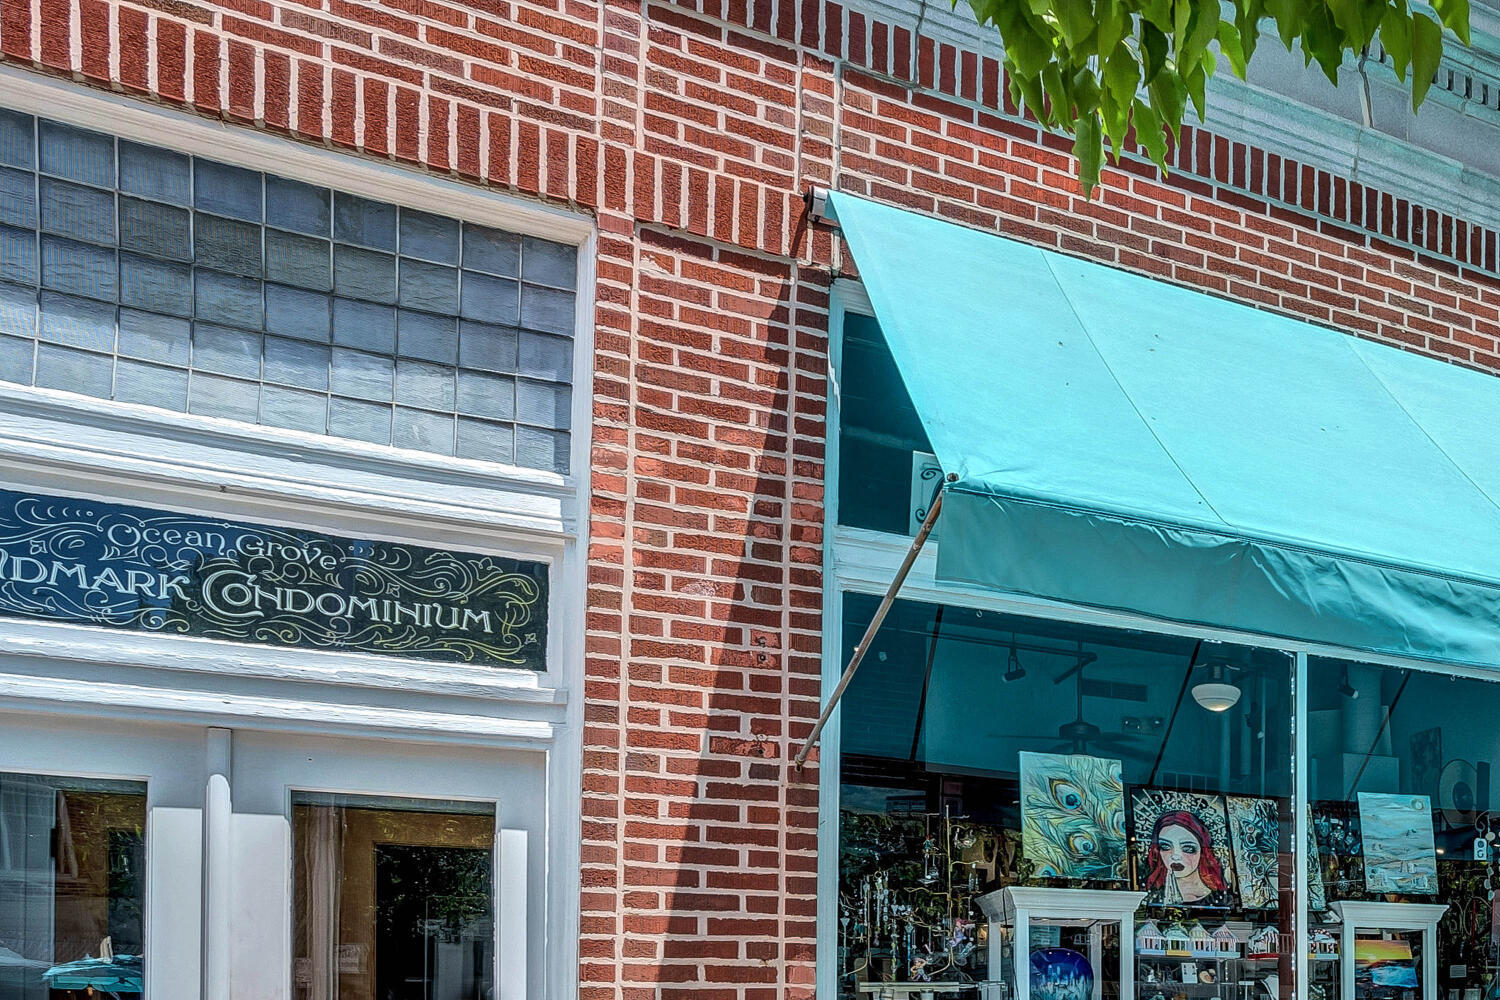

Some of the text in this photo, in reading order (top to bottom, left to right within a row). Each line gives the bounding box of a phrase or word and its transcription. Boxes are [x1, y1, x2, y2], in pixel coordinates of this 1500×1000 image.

[107, 522, 338, 570] Ocean Grove
[202, 569, 493, 634] CONDOMINIUM
